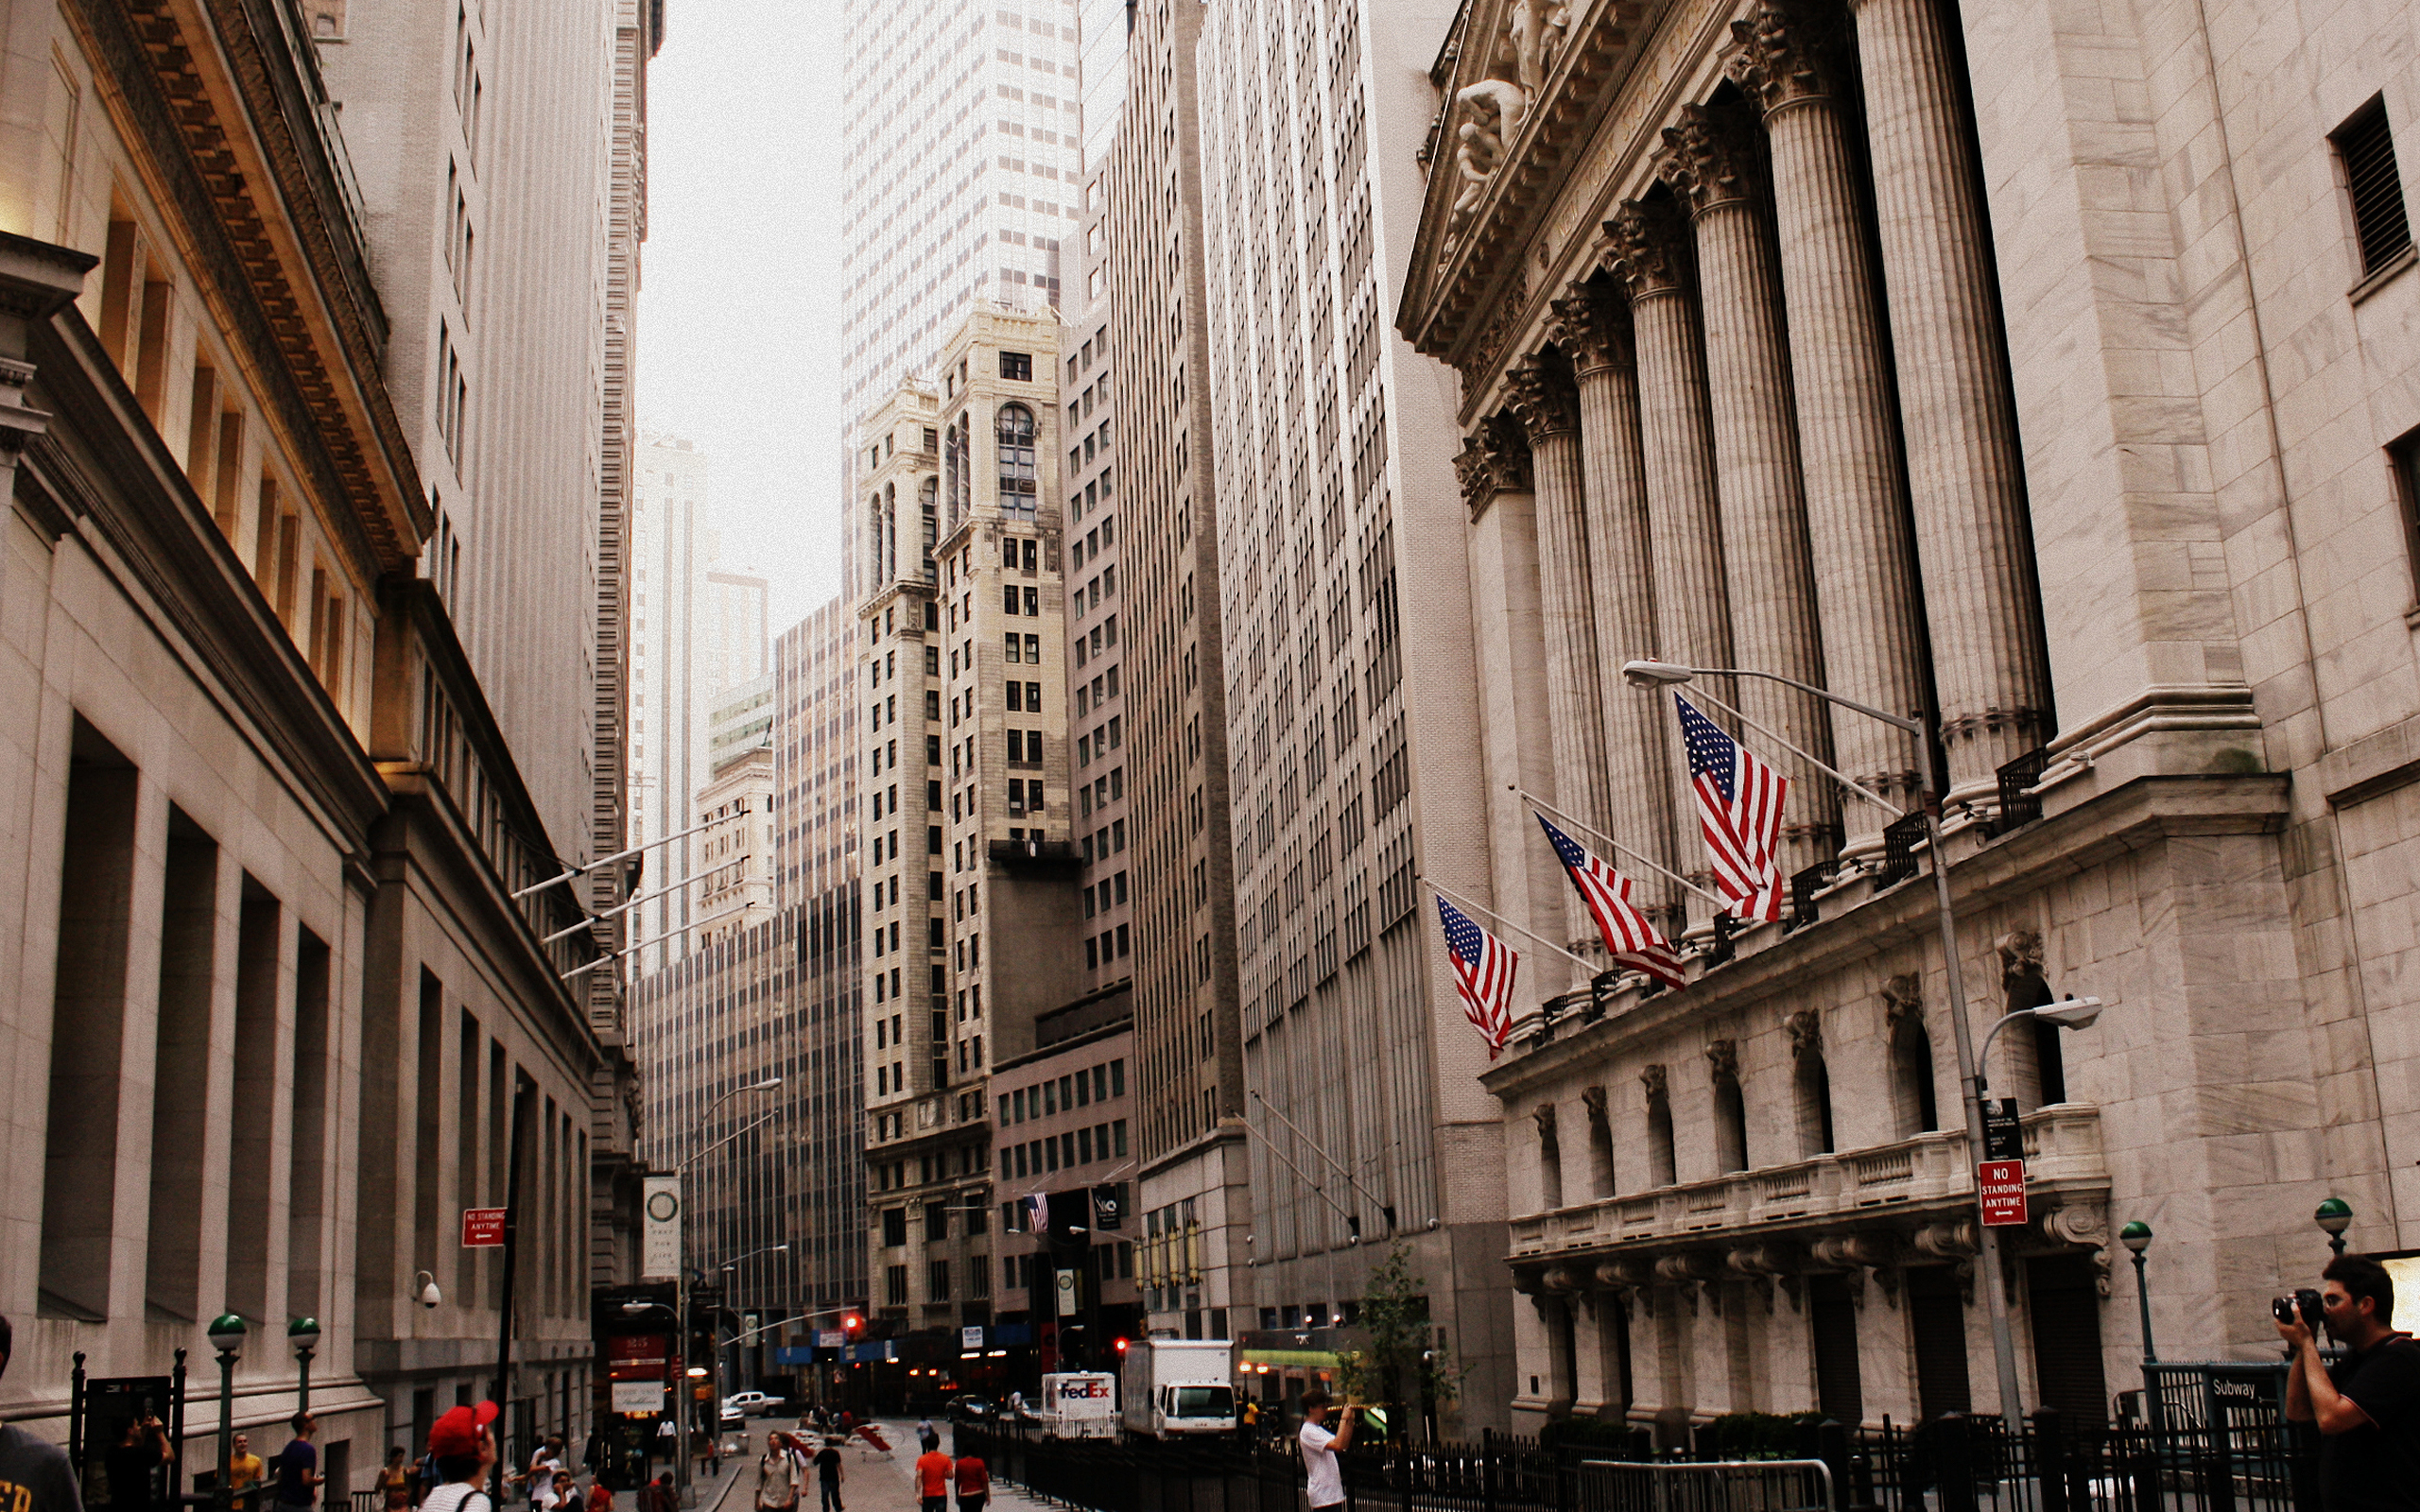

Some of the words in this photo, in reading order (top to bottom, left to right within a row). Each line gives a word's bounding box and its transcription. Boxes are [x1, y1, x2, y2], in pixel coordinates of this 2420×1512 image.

[1585, 130, 1617, 200] YORK
[1621, 58, 1663, 142] STOCK
[1993, 1168, 2009, 1180] NO
[1981, 1183, 2023, 1195] STANDING
[1985, 1196, 2022, 1208] ANYTIME
[1061, 1382, 1110, 1399] FedEx
[2213, 1378, 2256, 1400] Subway
